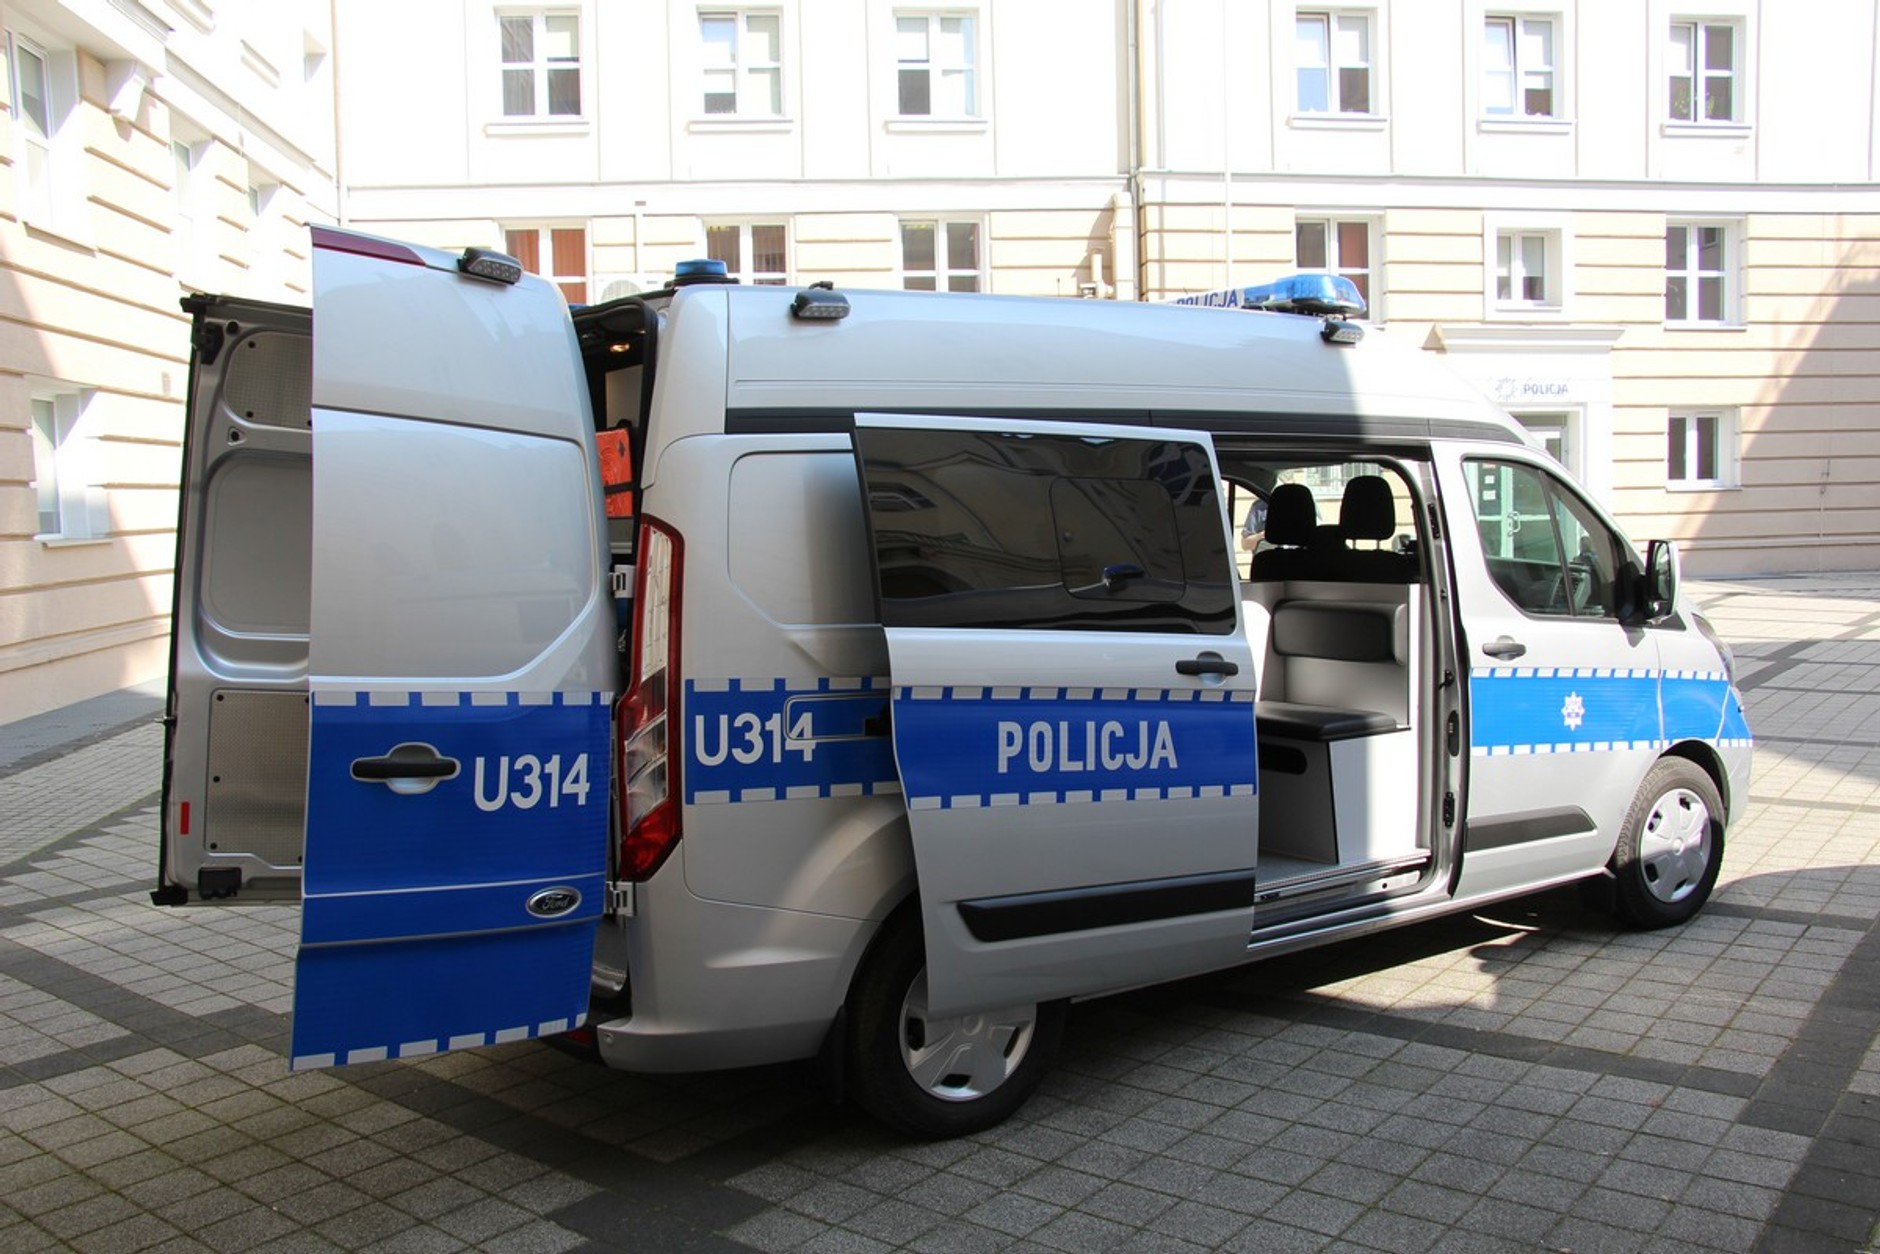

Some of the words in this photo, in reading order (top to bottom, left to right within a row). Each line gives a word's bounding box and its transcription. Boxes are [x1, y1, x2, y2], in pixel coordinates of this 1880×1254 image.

[1523, 383, 1569, 395] POLICJA
[695, 711, 816, 767] U314
[997, 720, 1178, 774] POLICJA
[473, 752, 590, 812] U314
[542, 894, 570, 910] Ford
